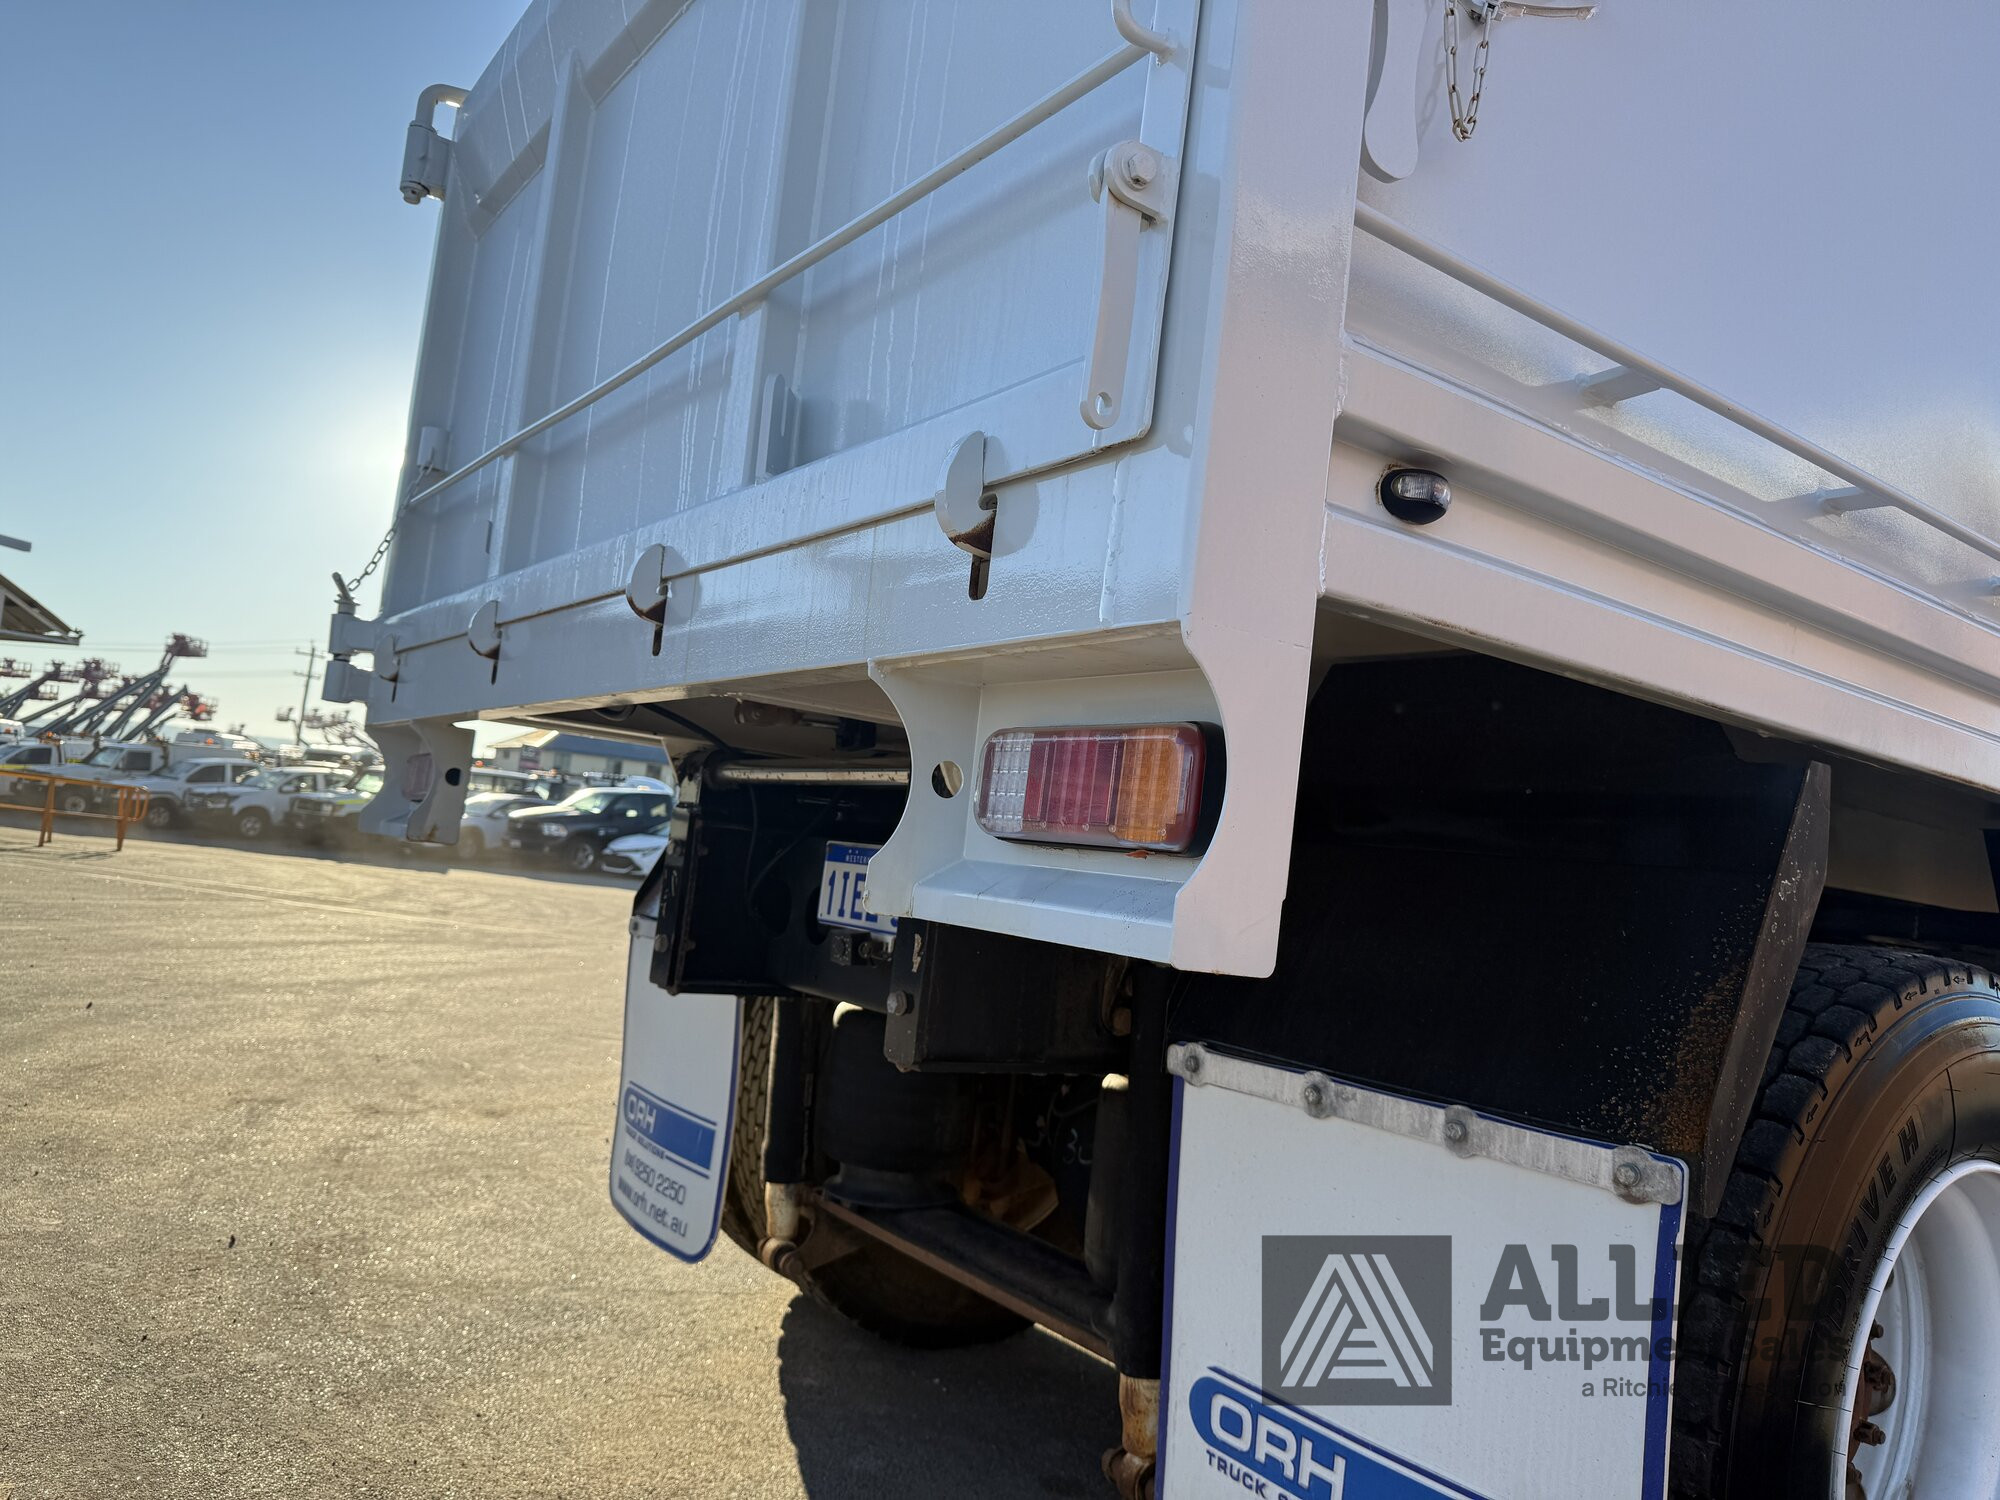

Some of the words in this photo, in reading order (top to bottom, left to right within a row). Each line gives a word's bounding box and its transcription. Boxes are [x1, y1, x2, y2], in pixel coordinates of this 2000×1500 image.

[628, 1094, 657, 1134] ORH
[656, 1172, 687, 1206] 2250
[1210, 1393, 1346, 1500] ORH
[1206, 1450, 1267, 1499] TRUCK
